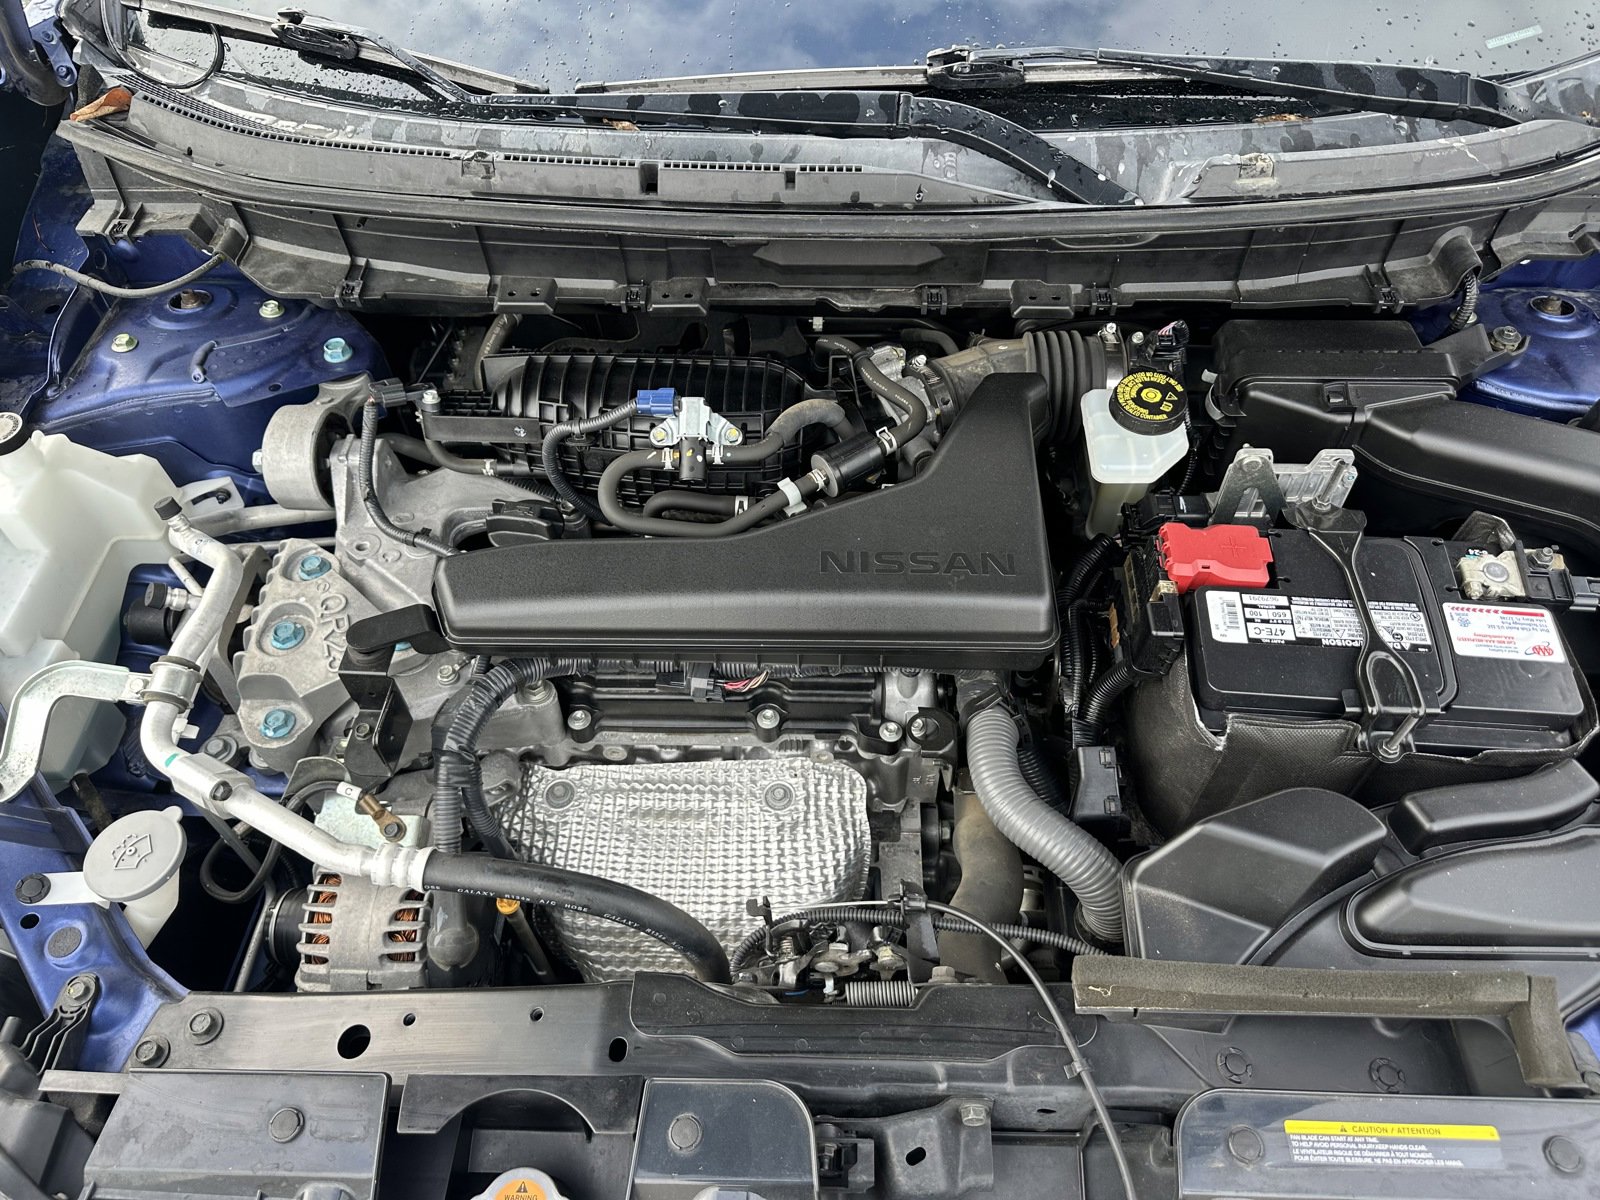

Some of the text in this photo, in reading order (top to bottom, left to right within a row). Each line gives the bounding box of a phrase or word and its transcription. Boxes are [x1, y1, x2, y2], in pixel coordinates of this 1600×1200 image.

[820, 551, 1016, 576] NISSAN
[1254, 627, 1286, 636] 47E-C
[1532, 645, 1553, 656] AAA
[457, 888, 495, 896] GALAXY
[565, 904, 588, 912] HOSE
[604, 913, 640, 927] GALAXY
[1352, 1125, 1388, 1134] CAUTION
[1397, 1127, 1441, 1135] ATTENTION
